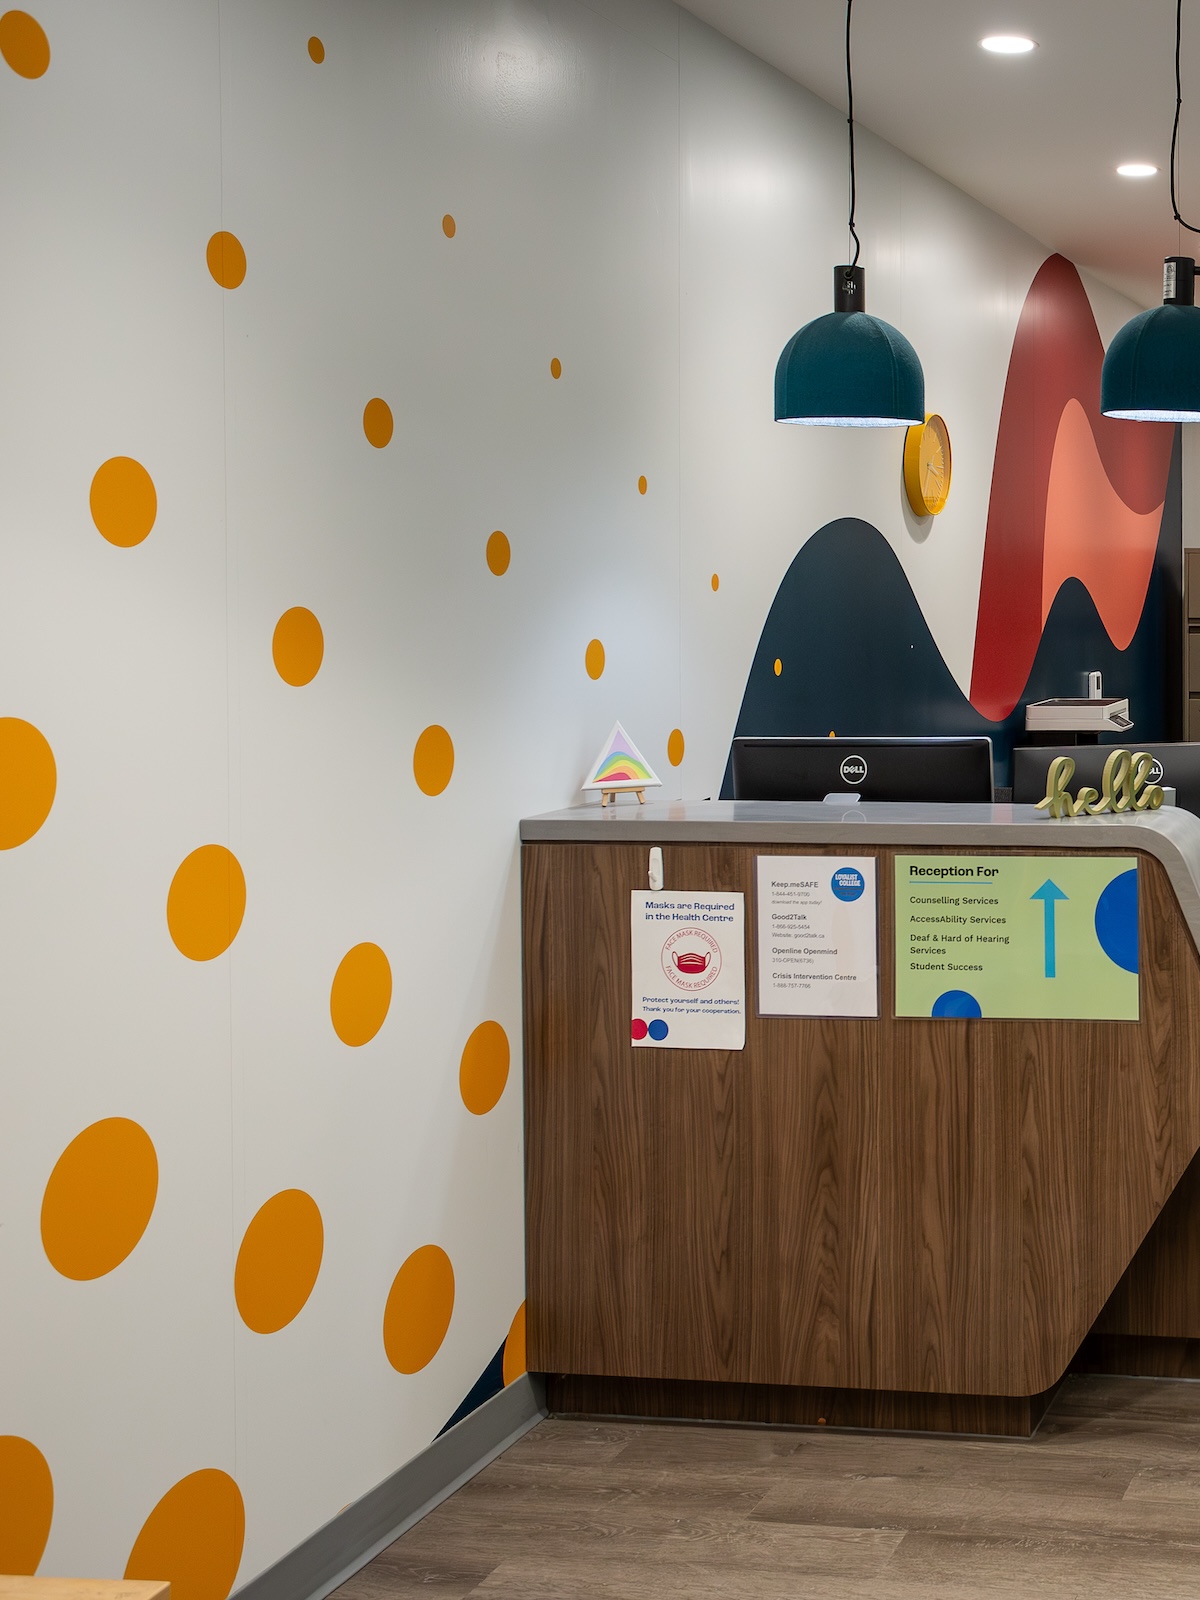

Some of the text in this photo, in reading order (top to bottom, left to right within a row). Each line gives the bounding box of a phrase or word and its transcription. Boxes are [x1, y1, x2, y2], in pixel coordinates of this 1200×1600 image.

[843, 765, 864, 774] DELL
[1033, 748, 1165, 819] hello
[909, 865, 999, 879] Reception For
[771, 881, 819, 889] Keep.meSAFE
[909, 896, 999, 906] Counselling Services
[645, 901, 735, 912] Masks are Required
[645, 912, 734, 922] in the Health Centre
[771, 913, 807, 921] Good2Talk
[909, 915, 1007, 925] AccessAbility Services
[665, 930, 718, 954] FACE MASK REQUIRED
[910, 933, 1010, 945] Deaf & Hard of Hearing
[771, 947, 838, 956] Openline Openmind
[910, 946, 946, 955] Services
[910, 962, 983, 972] Student Success
[665, 965, 718, 989] FACE MASK REQUIRED
[772, 972, 857, 982] Crisis Intervention Centre
[642, 996, 669, 1004] Protect
[670, 997, 699, 1005] yourself
[713, 998, 740, 1006] others!
[701, 1007, 741, 1015] cooperation.
